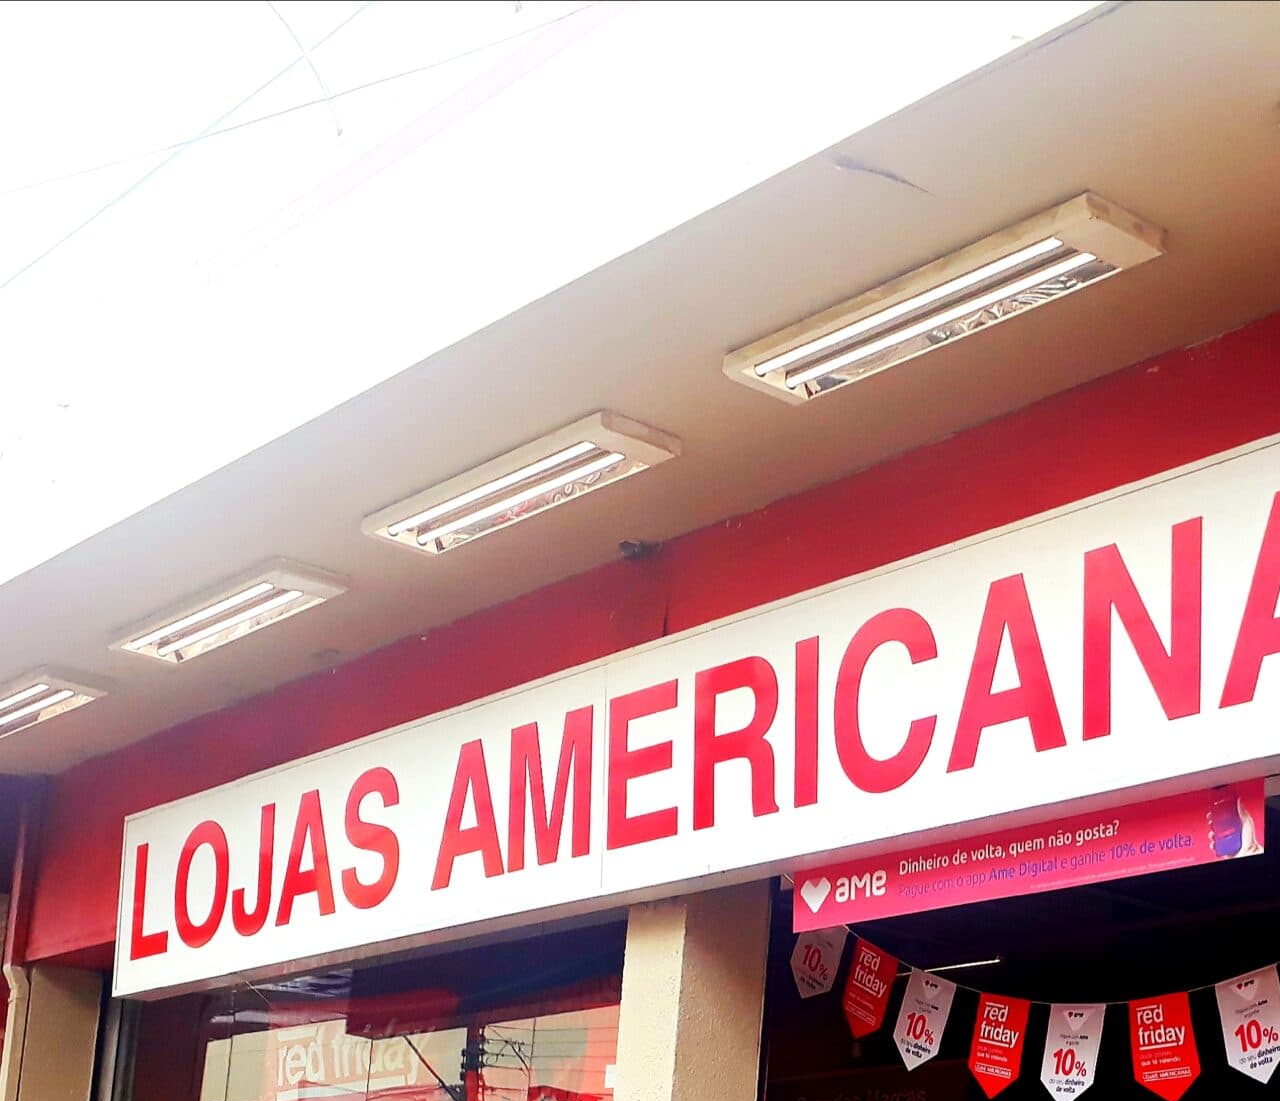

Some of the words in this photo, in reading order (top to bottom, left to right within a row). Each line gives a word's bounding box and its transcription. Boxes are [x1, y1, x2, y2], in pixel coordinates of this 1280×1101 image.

[129, 766, 401, 961] LOJAS
[899, 853, 949, 876] Dinheiro
[952, 849, 968, 865] de
[971, 842, 1006, 862] volta,
[1009, 839, 1045, 858] quem
[1048, 829, 1072, 848] não
[1075, 819, 1120, 847] gosta?
[966, 873, 986, 887] app
[989, 865, 1015, 881] Ame
[1019, 855, 1058, 878] Digital
[1070, 849, 1106, 872] ganhe
[1110, 842, 1135, 859] 10%
[1139, 838, 1155, 854] de
[802, 943, 829, 981] 10%
[858, 950, 881, 972] red
[854, 964, 888, 999] friday
[906, 1011, 934, 1046] 10%
[983, 1003, 1009, 1022] red
[1136, 1003, 1164, 1026] red
[980, 1020, 1020, 1049] friday
[1138, 1025, 1186, 1047] friday
[1234, 1019, 1279, 1053] 10%
[278, 1026, 327, 1087] red
[1053, 1048, 1087, 1077] 10%
[1258, 1057, 1273, 1067] volta
